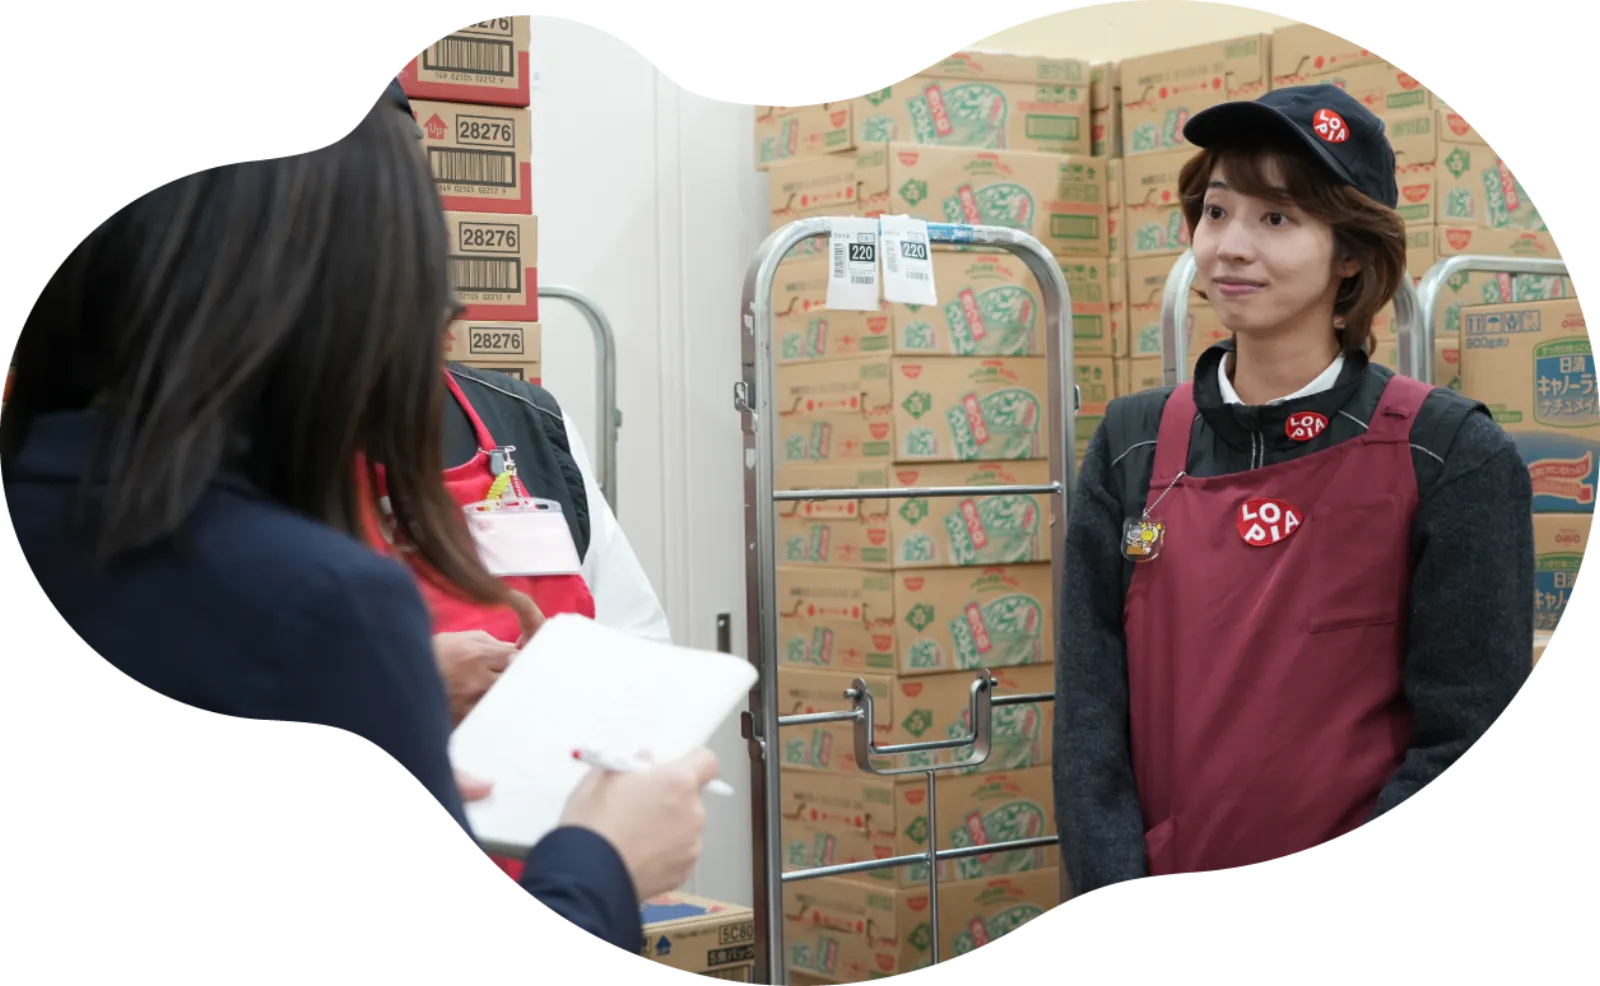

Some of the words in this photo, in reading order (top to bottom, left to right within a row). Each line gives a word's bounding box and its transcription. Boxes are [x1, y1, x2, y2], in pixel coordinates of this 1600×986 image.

[459, 121, 512, 142] 28276
[463, 228, 517, 248] 28276
[852, 245, 873, 261] 220
[903, 242, 925, 258] 220
[473, 333, 521, 350] 28276
[1560, 356, 1586, 373] 日清
